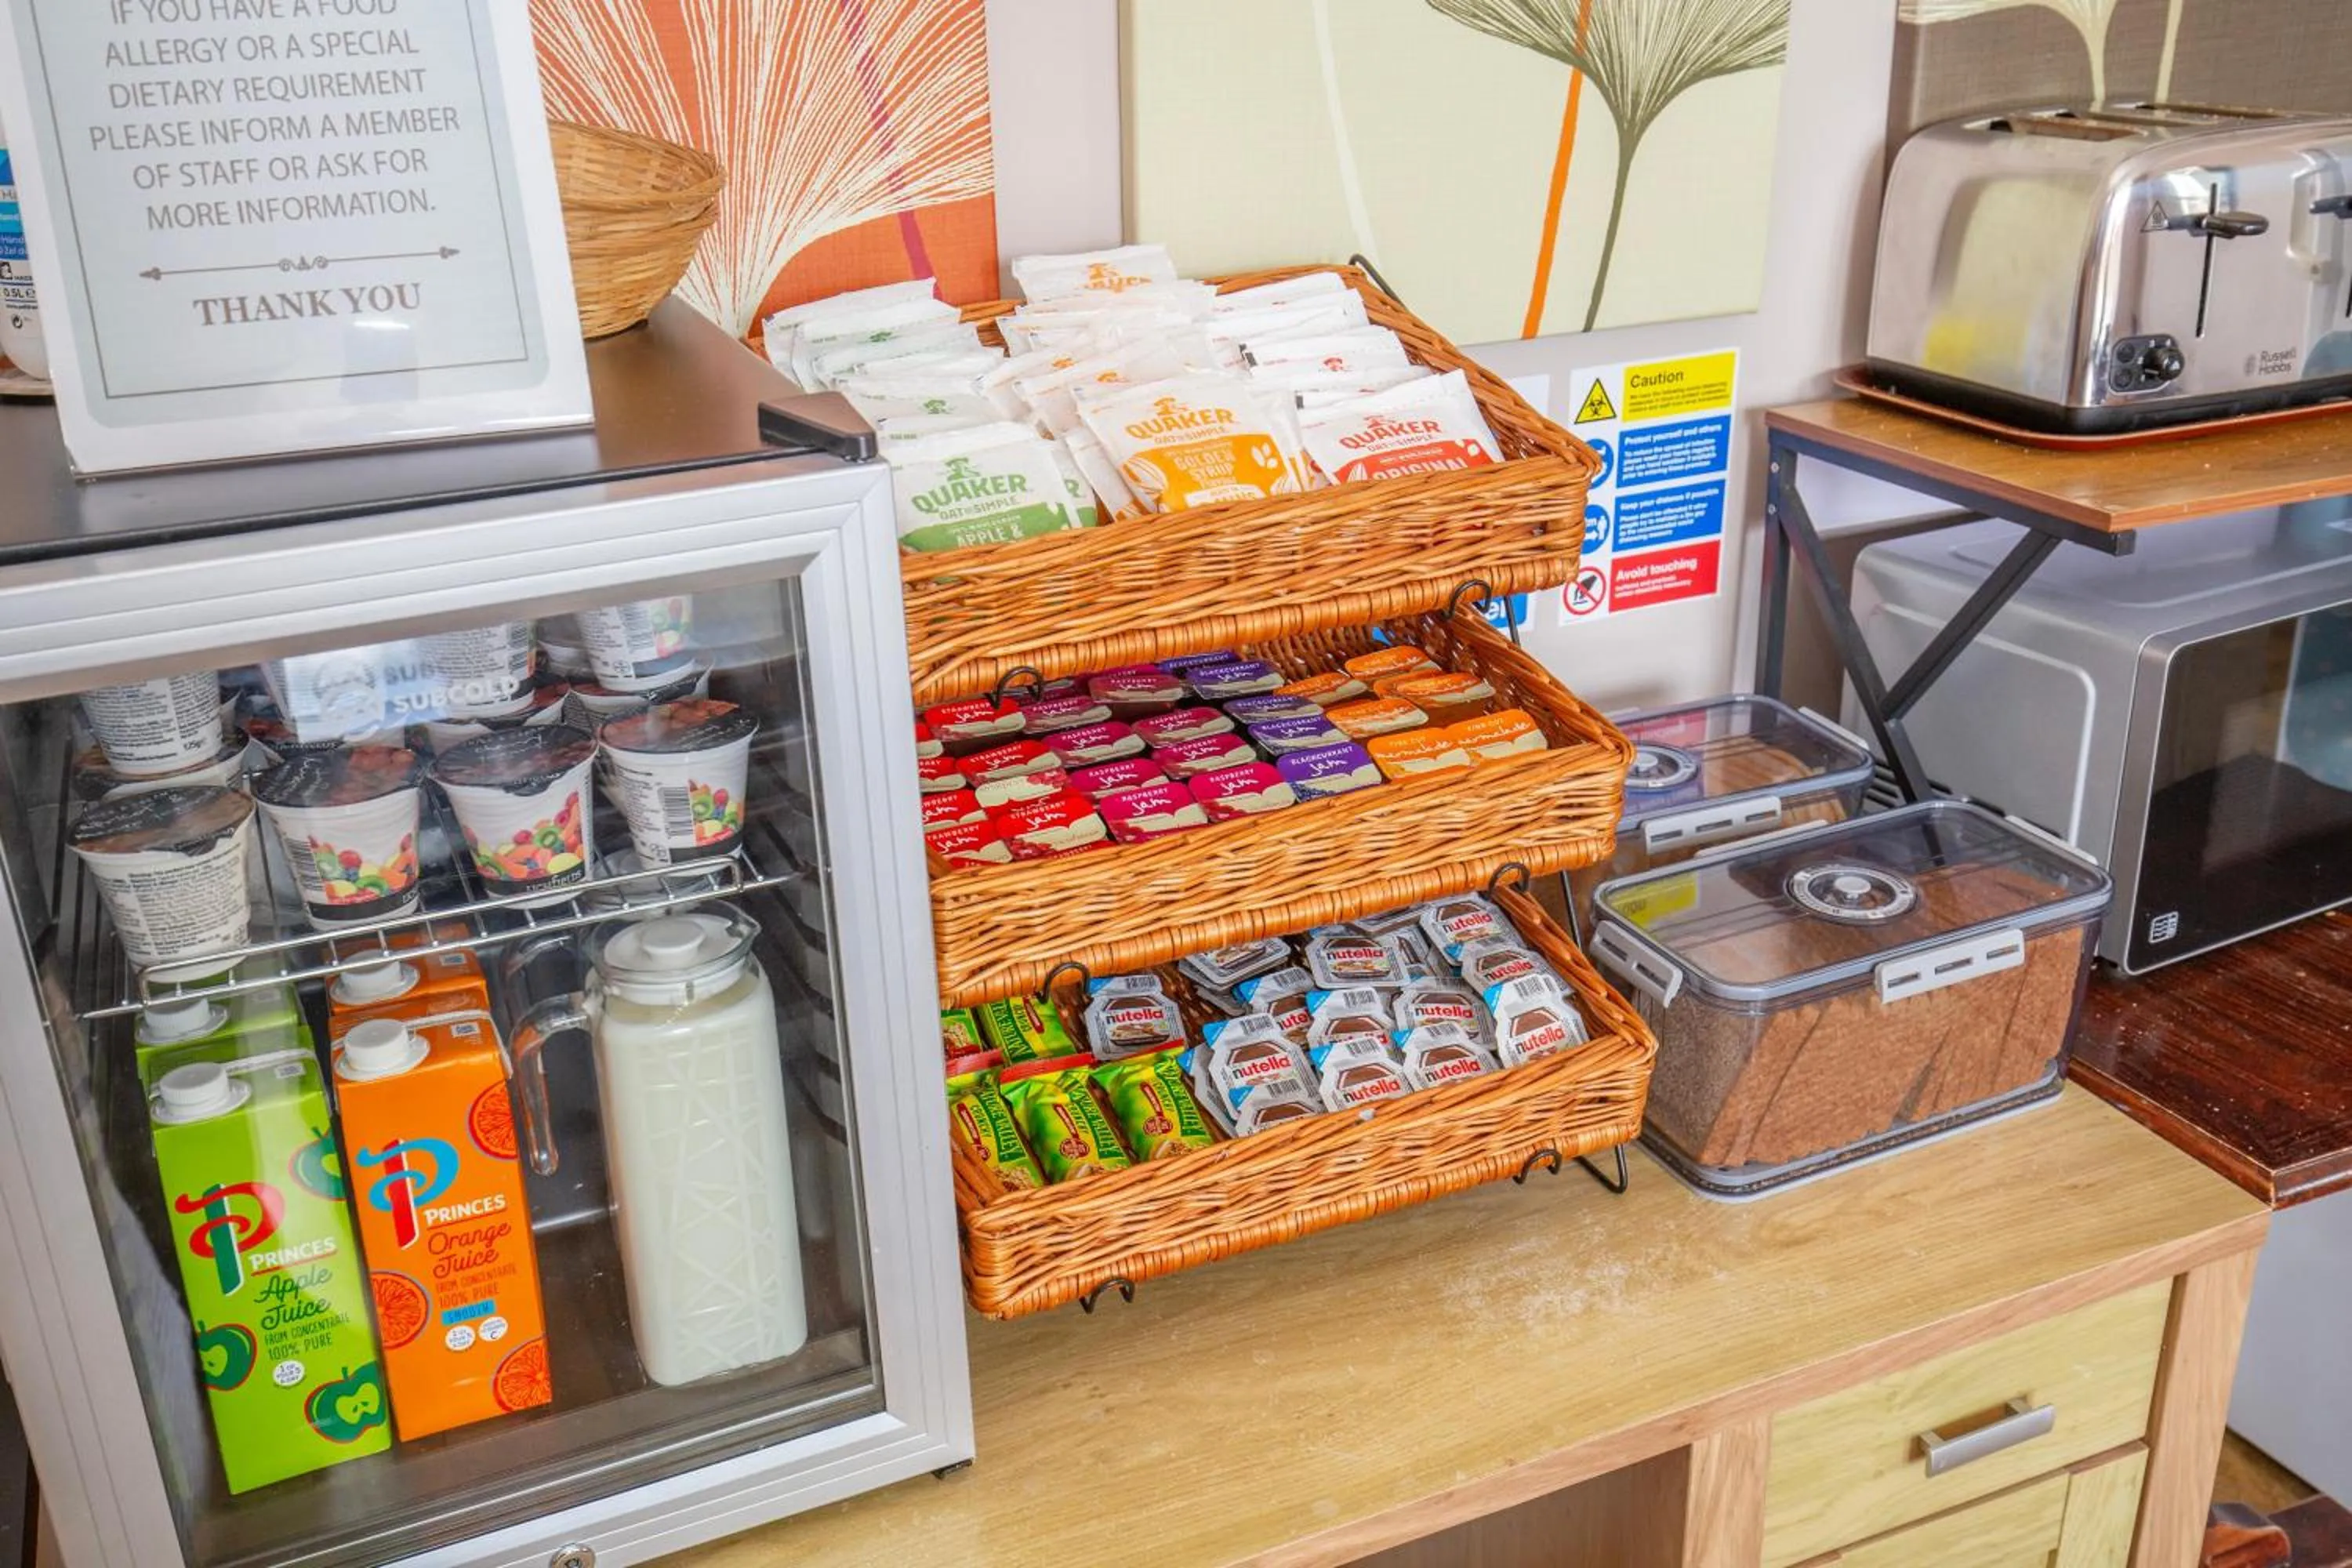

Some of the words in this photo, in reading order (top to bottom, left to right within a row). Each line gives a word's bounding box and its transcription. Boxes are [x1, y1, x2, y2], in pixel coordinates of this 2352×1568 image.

[111, 2, 134, 25] IF
[143, 0, 201, 24] YOU
[210, 0, 285, 21] HAVE
[292, 0, 312, 17] A
[319, 0, 396, 15] FOOD
[105, 36, 228, 68] ALLERGY
[238, 35, 278, 61] OR
[286, 34, 305, 60] A
[312, 29, 420, 58] SPECIAL
[109, 79, 225, 109] DIETARY
[234, 68, 426, 103] REQUIREMENT
[89, 121, 195, 151] PLEASE
[201, 115, 311, 146] INFORM
[320, 114, 339, 139] A
[345, 106, 460, 137] MEMBER
[132, 164, 171, 190] OF
[179, 158, 260, 187] STAFF
[268, 155, 309, 182] OR
[316, 151, 368, 180] ASK
[375, 148, 428, 175] FOR
[147, 201, 230, 230] MORE
[237, 188, 436, 225] INFORMATION.
[193, 289, 337, 326] THANK
[339, 282, 421, 313] YOU
[1631, 371, 1684, 388] Caution
[1125, 408, 1236, 439] QUAKER
[1339, 419, 1443, 449] QUAKER
[912, 474, 1027, 514] QUAKER
[956, 529, 1007, 547] APPLE
[1616, 564, 1649, 582] Avoid
[1650, 557, 1698, 575] touching
[392, 677, 521, 713] SUBCOLD
[941, 702, 992, 714] STRAWBERR
[1062, 727, 1107, 740] RASPBERRY
[1261, 716, 1322, 730] BLACKCURRANT
[1173, 739, 1217, 753] RASPBERRY
[1291, 746, 1353, 765] BLACKCURRANT
[1088, 764, 1135, 777] RASPBERRY
[1209, 768, 1254, 782] RASPBERRY
[1122, 787, 1168, 802] RASPBERRY
[1011, 801, 1065, 819] STRAWBERRY
[927, 826, 979, 841] TRAWBERRY
[1443, 911, 1491, 935] nutella
[1327, 946, 1384, 961] nutella
[1488, 960, 1534, 982] nutella
[1106, 1008, 1164, 1024] nutella
[1413, 1003, 1473, 1019] nutella
[1515, 1025, 1565, 1055] nutella
[1232, 1055, 1291, 1080] nutella
[1425, 1059, 1481, 1084] nutella
[1344, 1078, 1401, 1103] nutella
[995, 1116, 1025, 1156] VALLEY
[423, 1195, 506, 1225] PRINCES
[428, 1222, 511, 1254] Orange
[249, 1237, 336, 1270] PRINCES
[433, 1249, 499, 1279] Juice
[253, 1265, 332, 1303] Apple
[262, 1298, 332, 1330] Juice
[265, 1331, 288, 1346] FROM
[292, 1311, 350, 1338] CONCENTRATE
[268, 1341, 299, 1360] 100%
[304, 1333, 332, 1352] PURE
